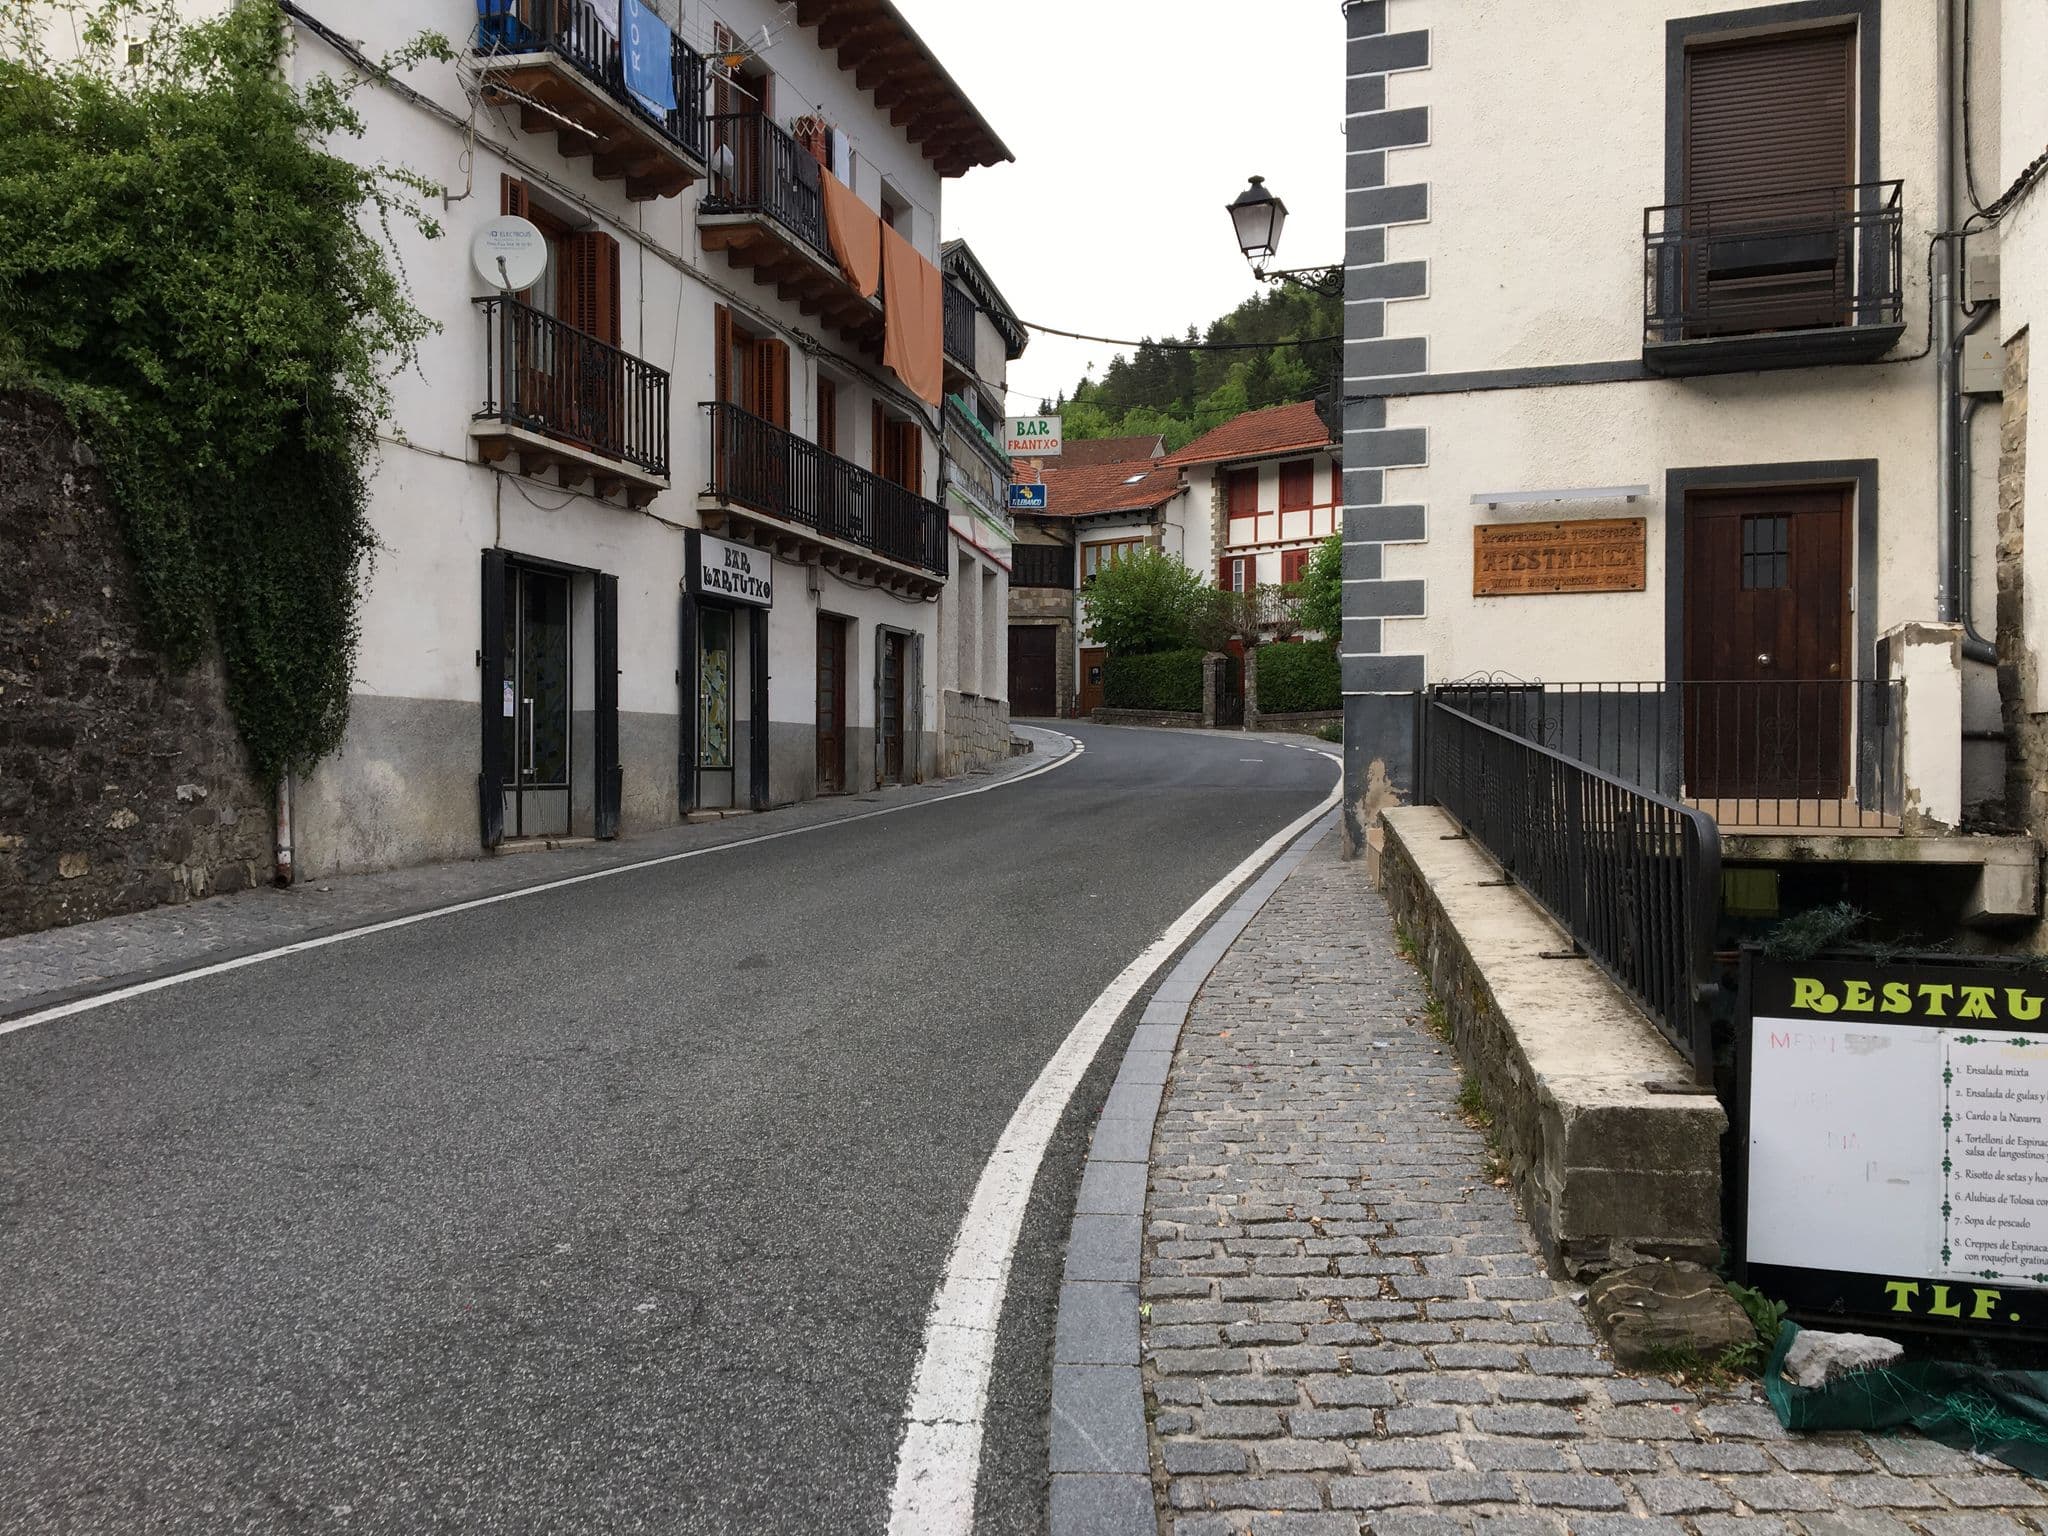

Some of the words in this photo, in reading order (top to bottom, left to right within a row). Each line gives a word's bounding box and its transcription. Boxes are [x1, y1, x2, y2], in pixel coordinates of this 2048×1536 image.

[1016, 420, 1050, 436] BAR
[1007, 439, 1058, 450] FRANTXO
[724, 547, 751, 575] BAR
[702, 565, 771, 599] KARTUTXO
[1790, 977, 2046, 1021] RESTAU
[1966, 1065, 2003, 1076] Ensalada
[2005, 1067, 2029, 1077] mixta
[1966, 1088, 2003, 1098] Ensalada
[2005, 1089, 2015, 1099] de
[2016, 1089, 2039, 1103] gulas
[2039, 1094, 2046, 1104] y
[1955, 1113, 1963, 1122] 3.
[1965, 1110, 1990, 1121] Cardo
[1999, 1111, 2007, 1121] la
[2009, 1112, 2042, 1124] Navarra
[1955, 1136, 1963, 1144] 4.
[1965, 1133, 2003, 1144] Tortelloni
[2005, 1134, 2015, 1145] de
[1965, 1145, 1985, 1157] salsa
[1987, 1146, 1997, 1157] de
[1999, 1147, 2045, 1161] langostinos
[1954, 1171, 1962, 1180] 5.
[1965, 1169, 1994, 1180] Risotto
[1995, 1170, 2005, 1181] de
[2006, 1172, 2027, 1182] setas
[2028, 1175, 2033, 1185] y
[1954, 1192, 1962, 1201] 6.
[1964, 1191, 1995, 1203] Alubias
[1997, 1193, 2008, 1204] de
[2009, 1194, 2034, 1205] Tolosa
[1954, 1217, 1962, 1226] 7.
[1964, 1215, 1985, 1228] Sopa
[1986, 1216, 1996, 1226] de
[1998, 1217, 2031, 1229] pescado
[1954, 1238, 1962, 1247] 8.
[1964, 1238, 1998, 1252] Creppes
[1999, 1240, 2009, 1250] de
[2011, 1240, 2048, 1253] Espinaca
[1964, 1253, 1979, 1261] con
[1981, 1253, 2018, 1266] roquefort
[1884, 1281, 2021, 1322] TLF.
